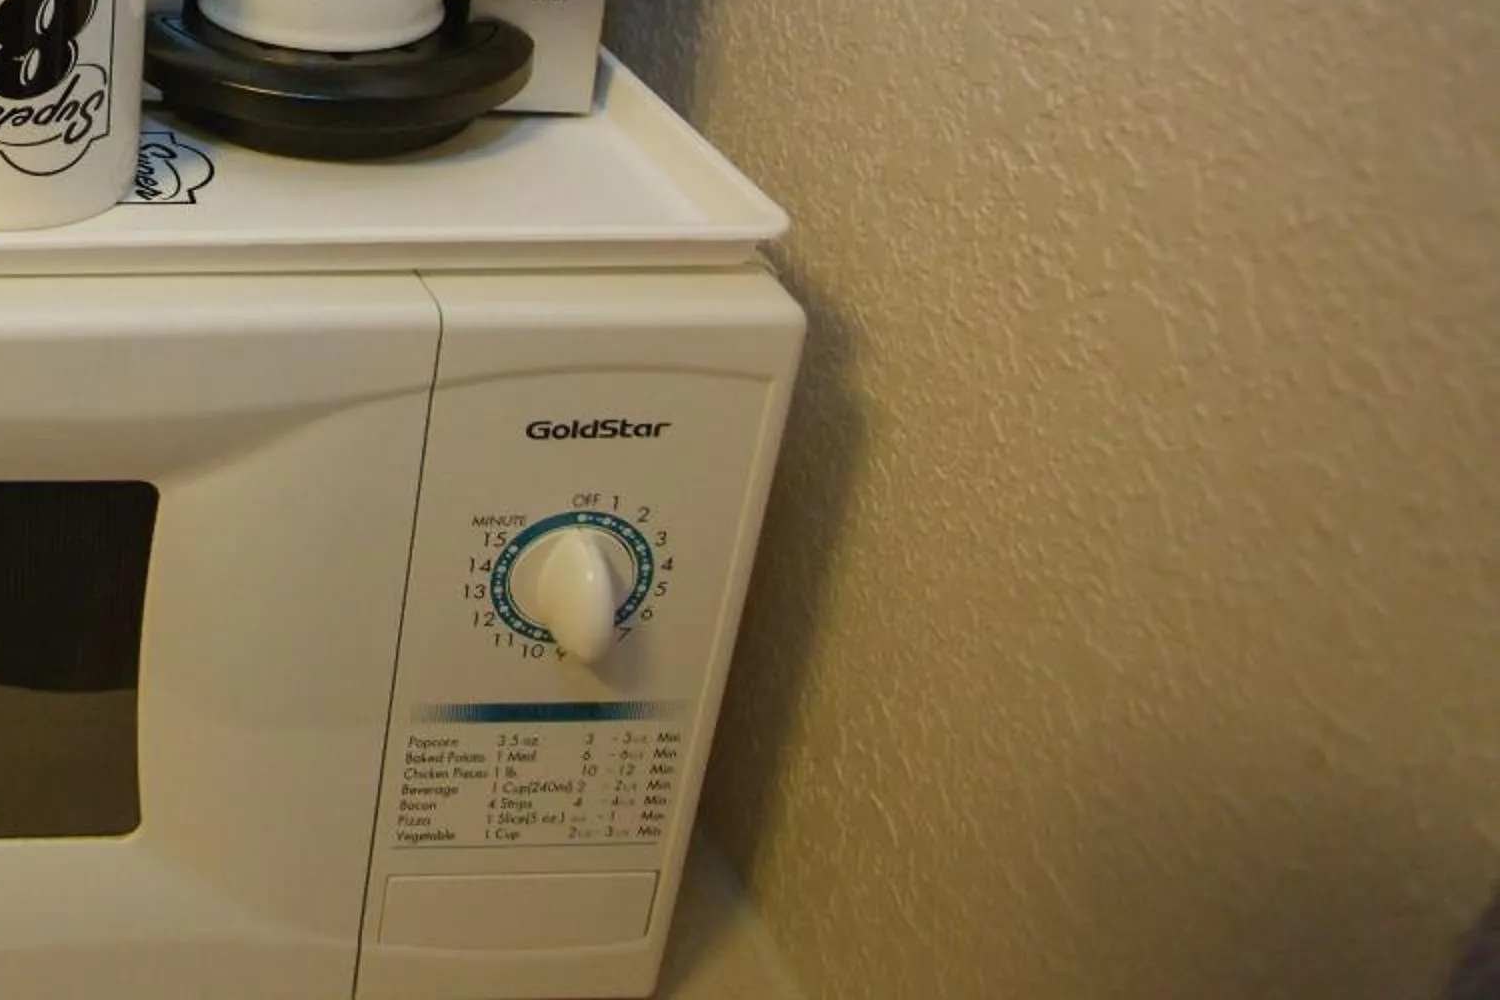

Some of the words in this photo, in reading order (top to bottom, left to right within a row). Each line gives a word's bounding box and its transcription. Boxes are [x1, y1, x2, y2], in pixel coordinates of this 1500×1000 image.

[526, 418, 673, 440] GoldStar
[572, 494, 601, 508] OFF
[612, 495, 619, 510] 1
[471, 515, 527, 527] MINUTE
[638, 507, 650, 522] 2
[483, 532, 507, 546] 15
[655, 531, 667, 546] 3
[469, 557, 491, 572] 14
[660, 557, 674, 571] 4
[464, 585, 486, 599] 13
[653, 581, 668, 597] 5
[473, 611, 496, 627] 12
[640, 604, 654, 621] 6
[494, 633, 513, 647] 11
[617, 627, 632, 641] 7
[522, 645, 545, 659] 10
[407, 735, 459, 748] Popcorn
[405, 751, 444, 764] Baked
[404, 767, 449, 779] Chicken
[581, 764, 598, 777] 10
[401, 784, 459, 798] Beverage
[399, 800, 437, 811] Bacon
[397, 815, 431, 826] Pizza
[396, 829, 456, 843] Vegetable
